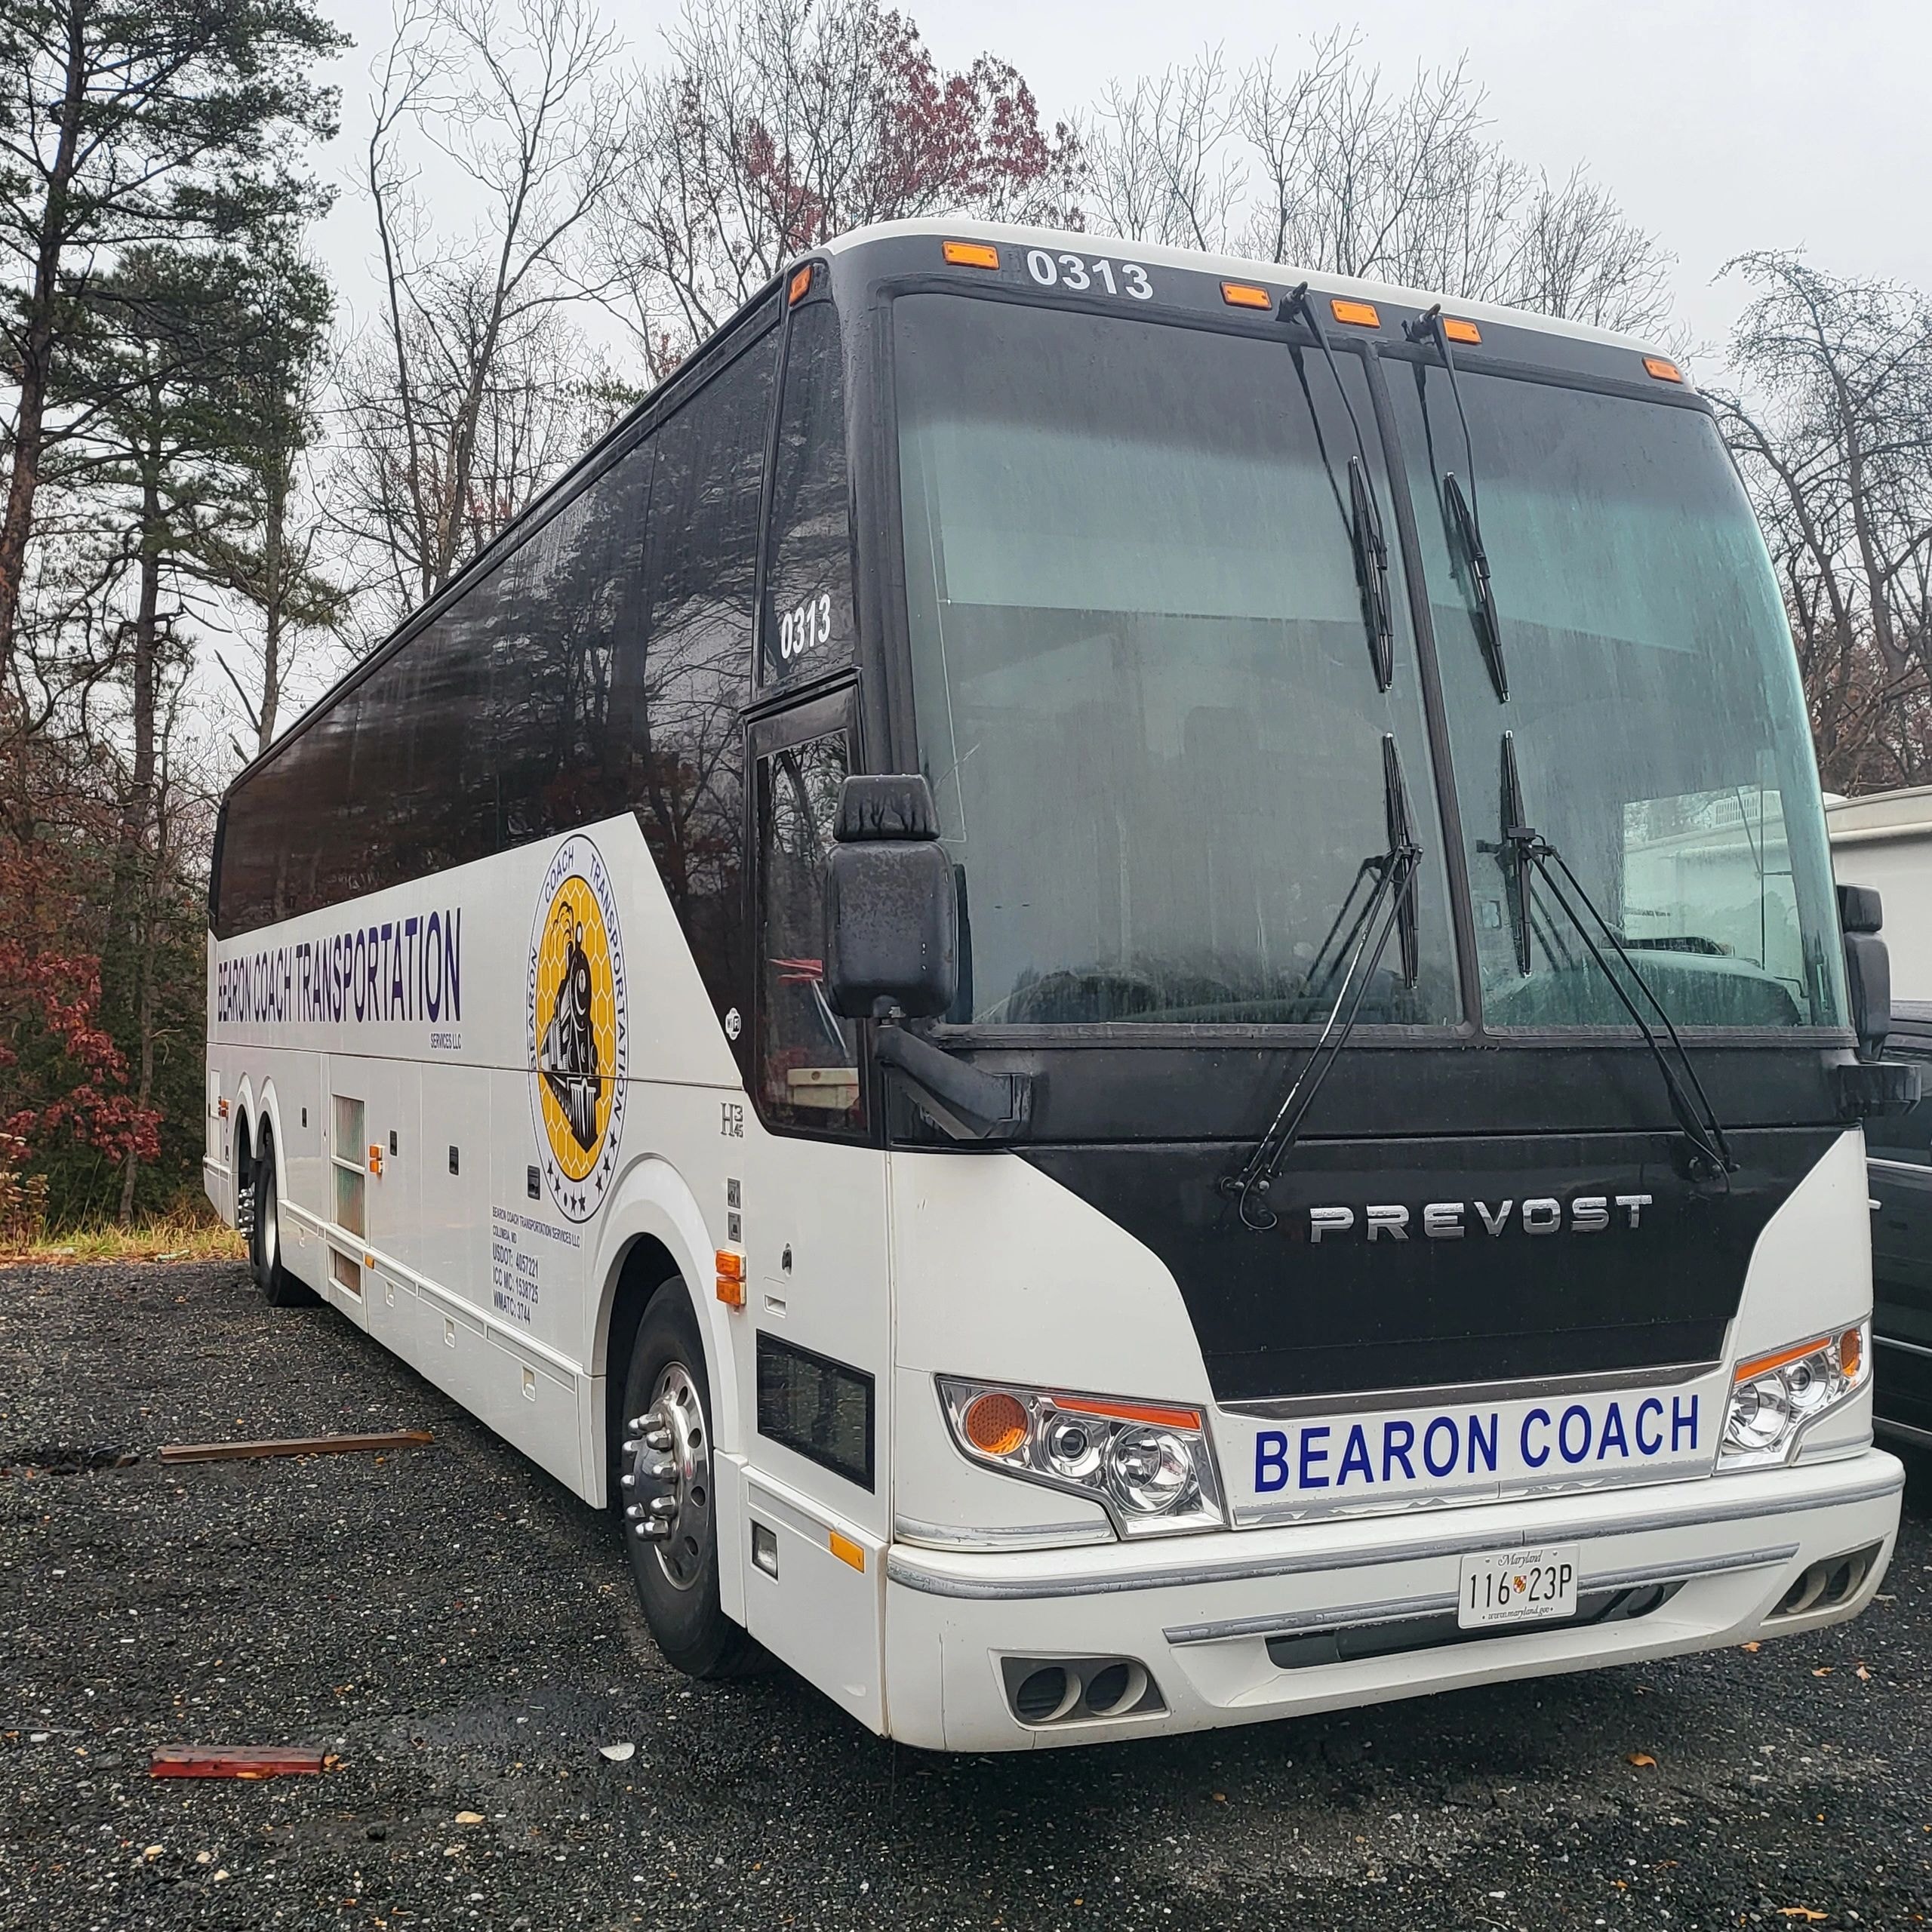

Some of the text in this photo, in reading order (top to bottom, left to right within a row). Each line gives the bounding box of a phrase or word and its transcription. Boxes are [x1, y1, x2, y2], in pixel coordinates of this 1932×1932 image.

[1027, 250, 1154, 300] 0313
[780, 593, 831, 660] 0313
[217, 907, 461, 1023] BEARON COACH TRANSPORTATION
[528, 844, 626, 1123] BEARON COACH TRANSPORTATION
[430, 1032, 462, 1049] SERVICES LLC
[492, 1206, 580, 1248] BEARON COACH TRANSPORTATION SERVICES LLC
[1309, 1194, 1654, 1244] PREVOST
[492, 1241, 539, 1279] USDOT: 4057221
[492, 1265, 539, 1305] ICC MC: 1538725
[492, 1288, 531, 1325] WMATC: 3744
[1254, 1394, 1699, 1494] BEARON COACH
[1497, 1549, 1543, 1568] Maryland
[1470, 1563, 1572, 1609] 116 23P
[1487, 1604, 1550, 1620] www.maryland.gov
